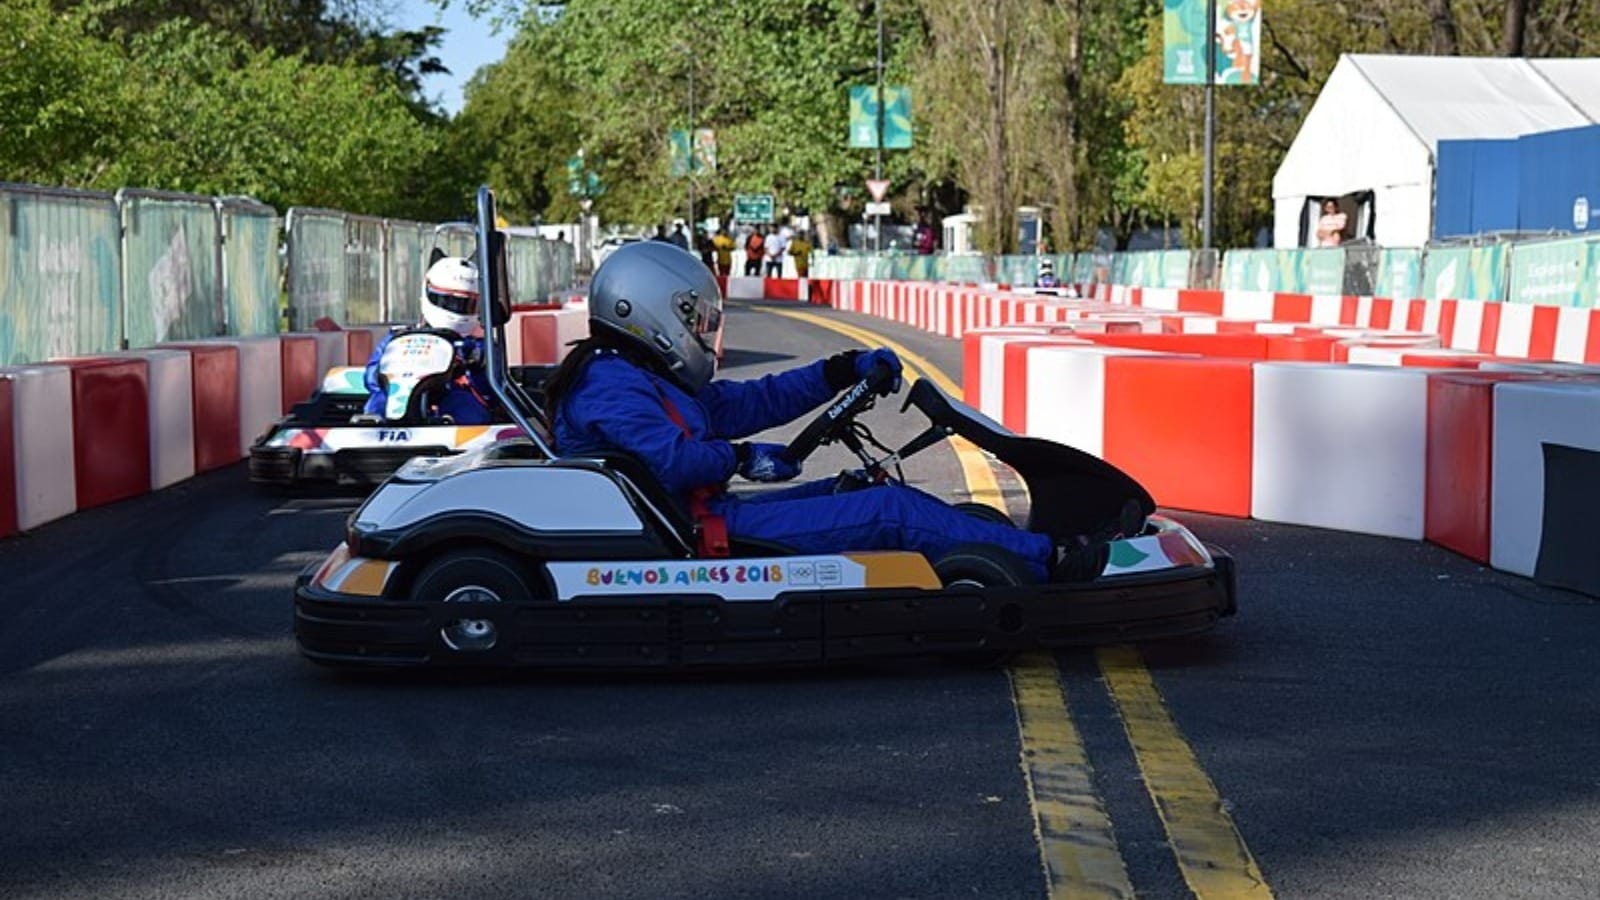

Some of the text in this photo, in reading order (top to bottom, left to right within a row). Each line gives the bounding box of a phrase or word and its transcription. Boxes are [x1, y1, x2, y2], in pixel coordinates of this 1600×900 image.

[586, 564, 783, 586] BUENOS AIRES 2018
